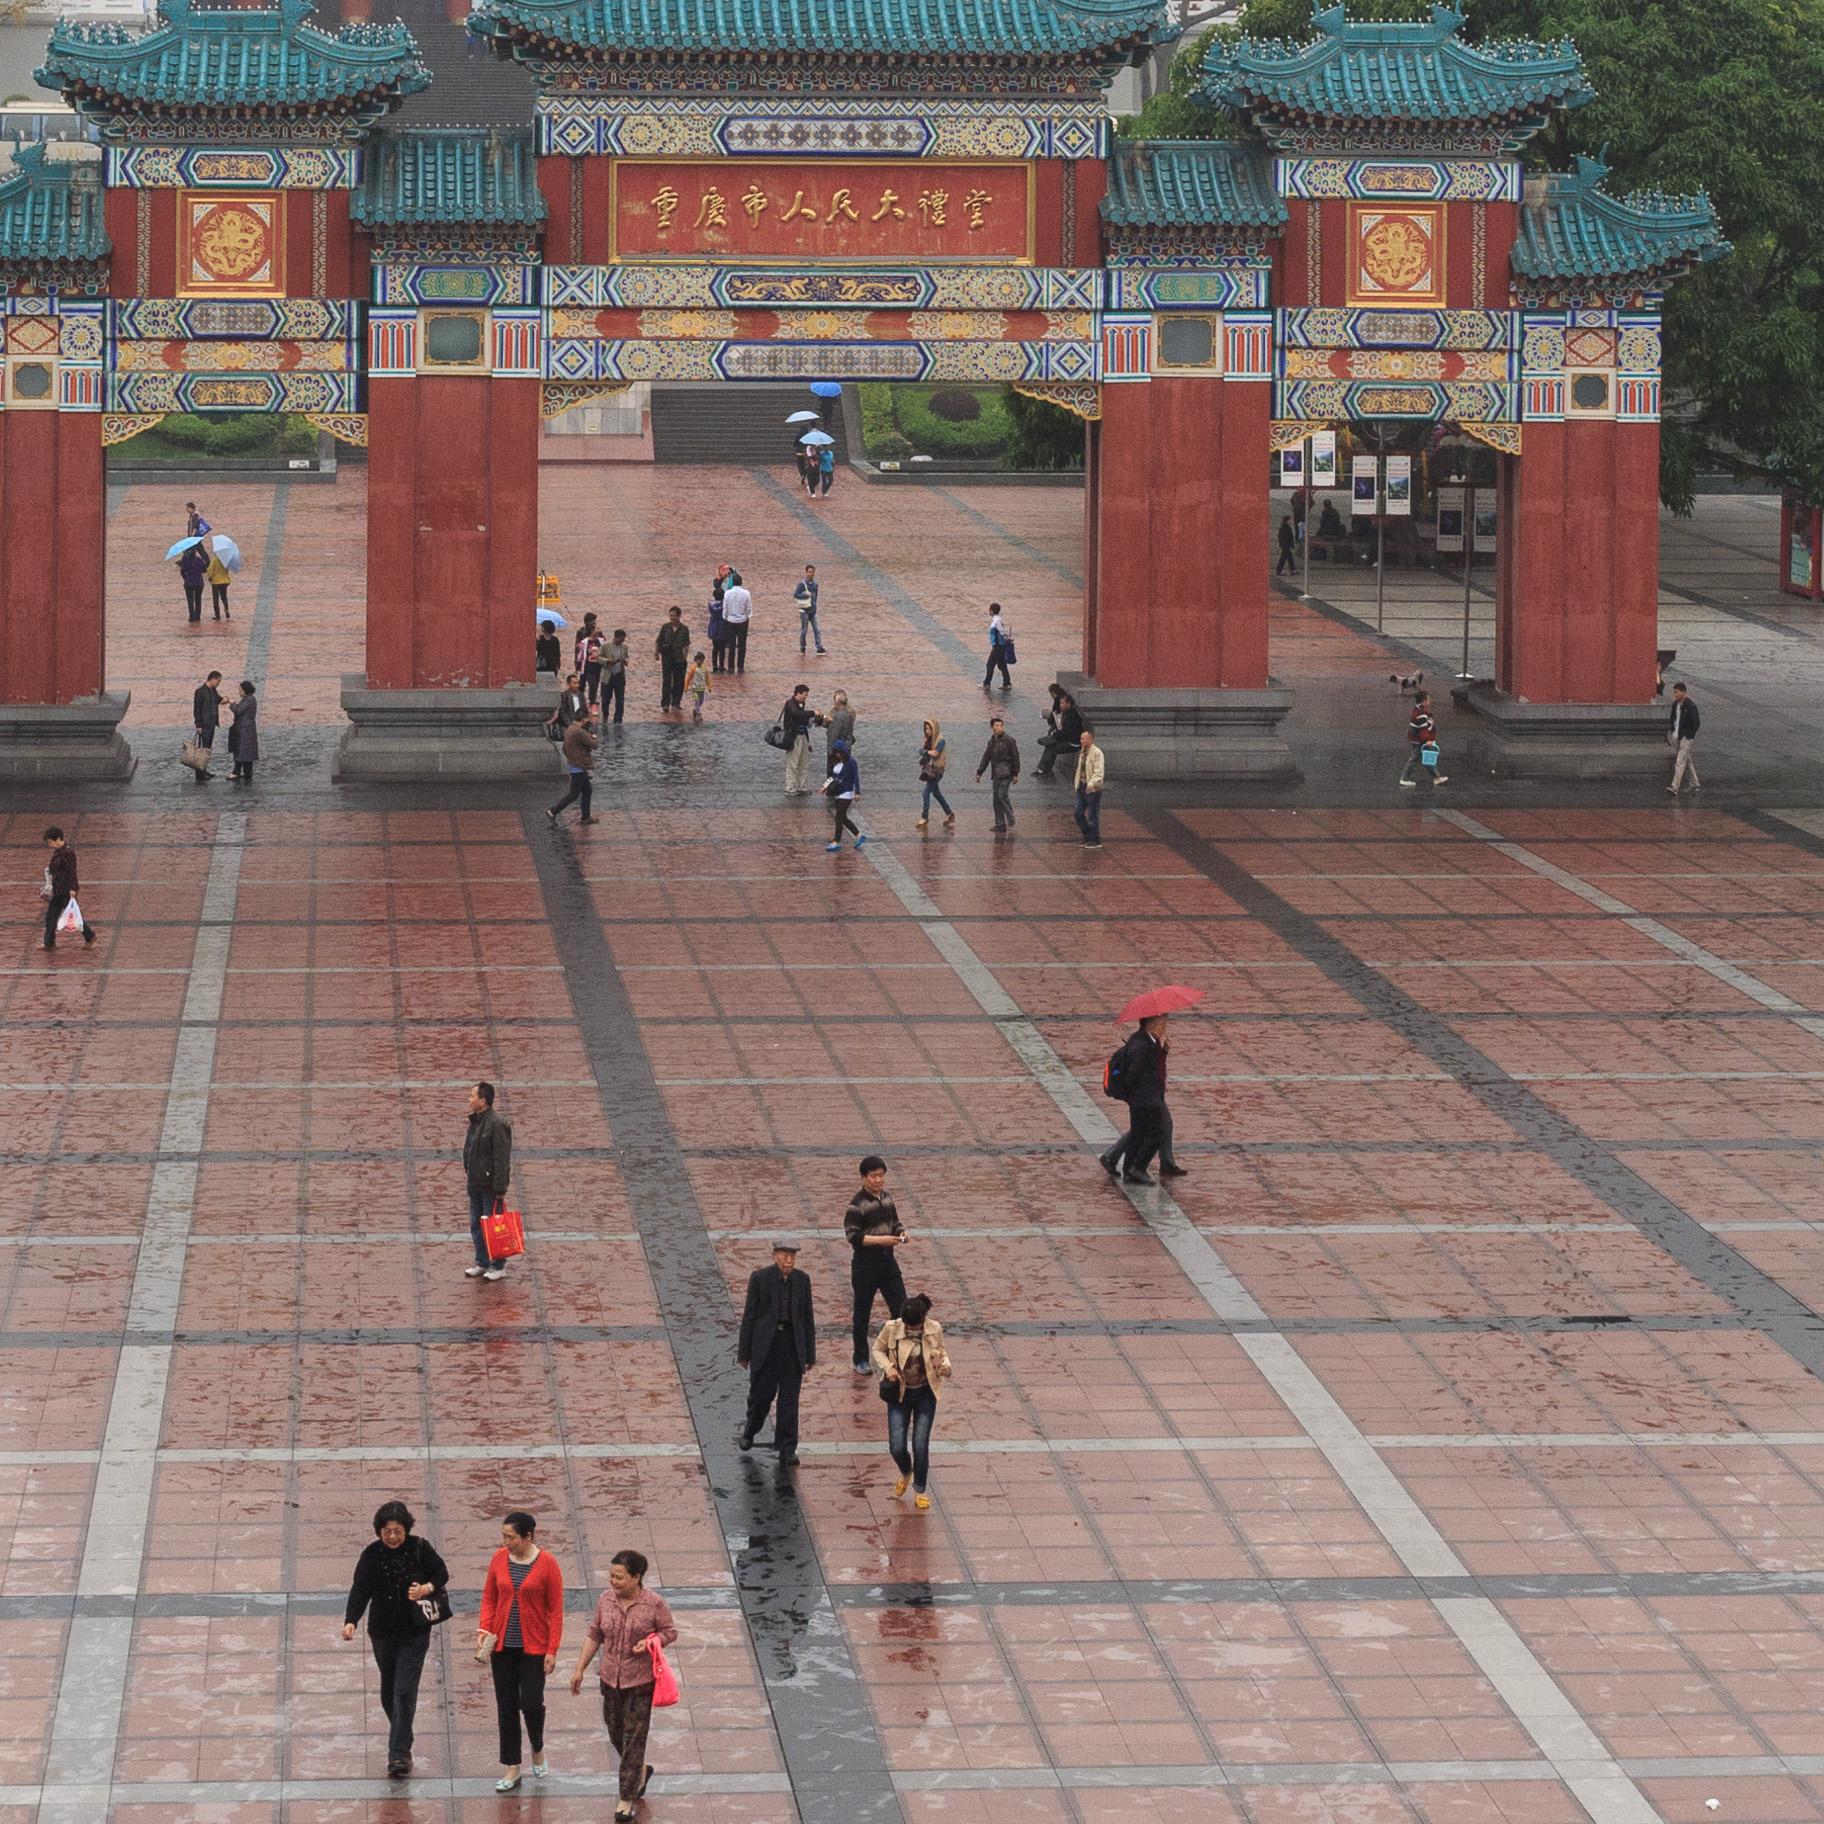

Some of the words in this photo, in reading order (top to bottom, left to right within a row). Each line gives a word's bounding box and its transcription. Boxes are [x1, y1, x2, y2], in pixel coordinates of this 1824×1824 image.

[650, 184, 993, 229] 重慶市人民大禮堂
